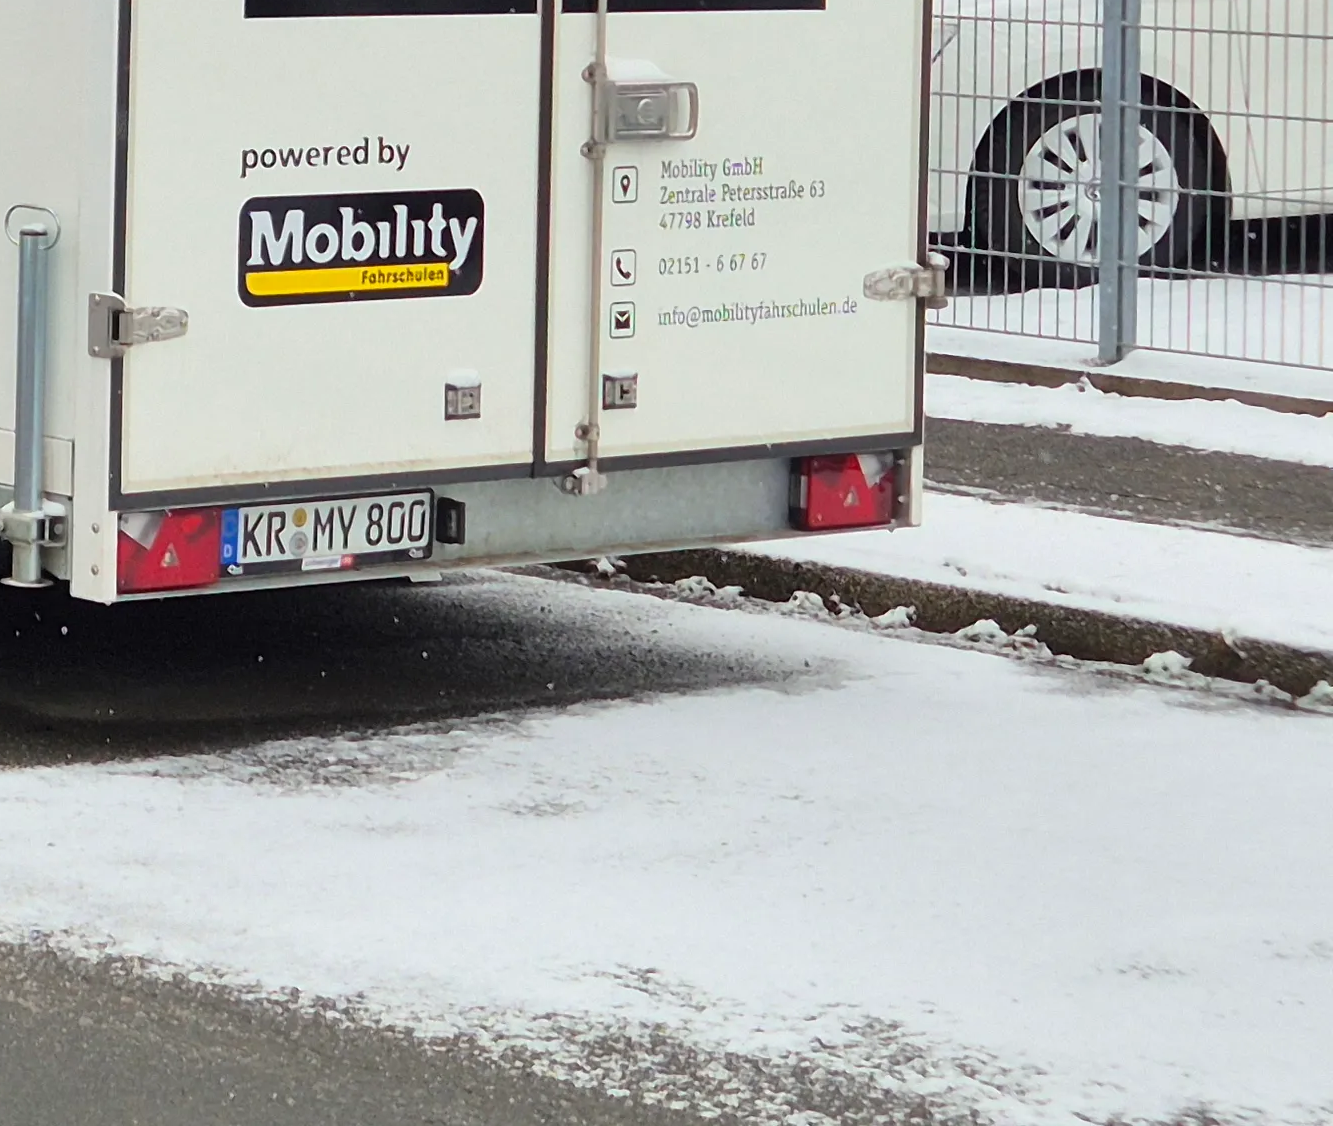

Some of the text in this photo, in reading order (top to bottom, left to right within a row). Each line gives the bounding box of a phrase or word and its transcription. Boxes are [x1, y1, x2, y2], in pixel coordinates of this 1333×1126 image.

[240, 136, 411, 178] powered by
[660, 156, 764, 182] Mobility GmbH
[659, 180, 826, 205] Zentrale Petersstraße 63
[659, 208, 755, 230] 47798 Krefeld
[245, 203, 478, 270] Mobility
[361, 267, 444, 285] Fahrschulen
[658, 256, 700, 275] 02151
[716, 254, 724, 272] 6
[730, 253, 746, 271] 67
[751, 252, 768, 270] 67
[658, 296, 858, 328] info@mobilityfahrschulen.de
[241, 499, 426, 559] KR MY 800
[223, 543, 232, 557] D
